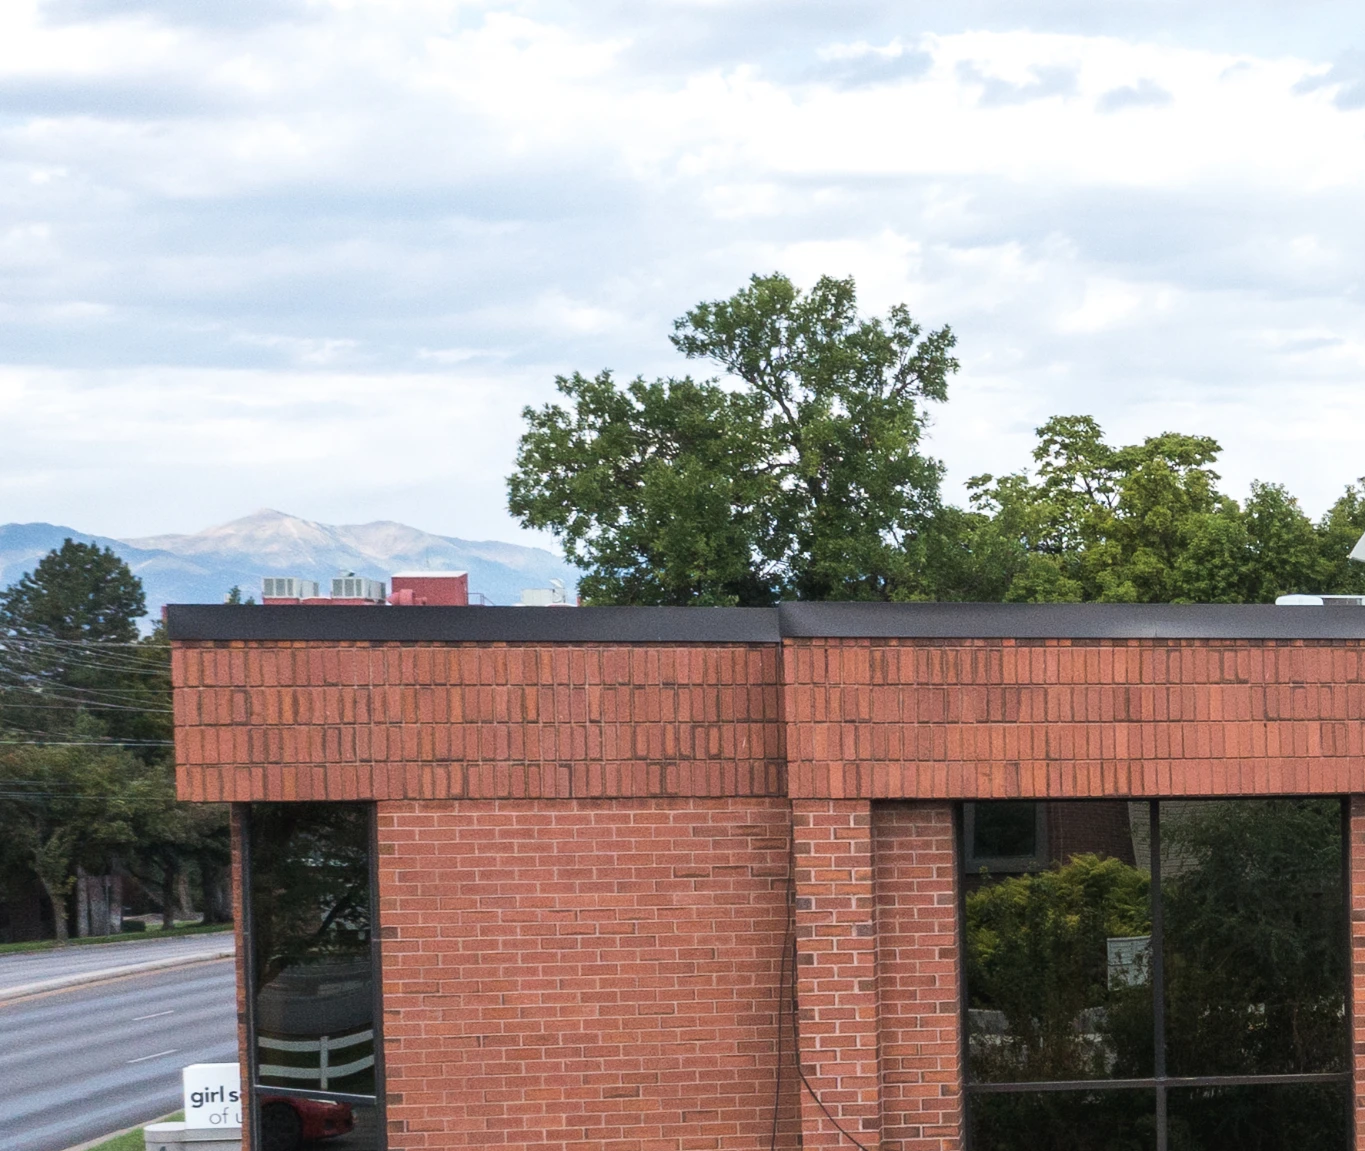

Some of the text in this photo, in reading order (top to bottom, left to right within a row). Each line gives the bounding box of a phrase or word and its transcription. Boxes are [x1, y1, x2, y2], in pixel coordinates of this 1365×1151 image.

[190, 1086, 241, 1108] girl s
[209, 1107, 229, 1124] of
